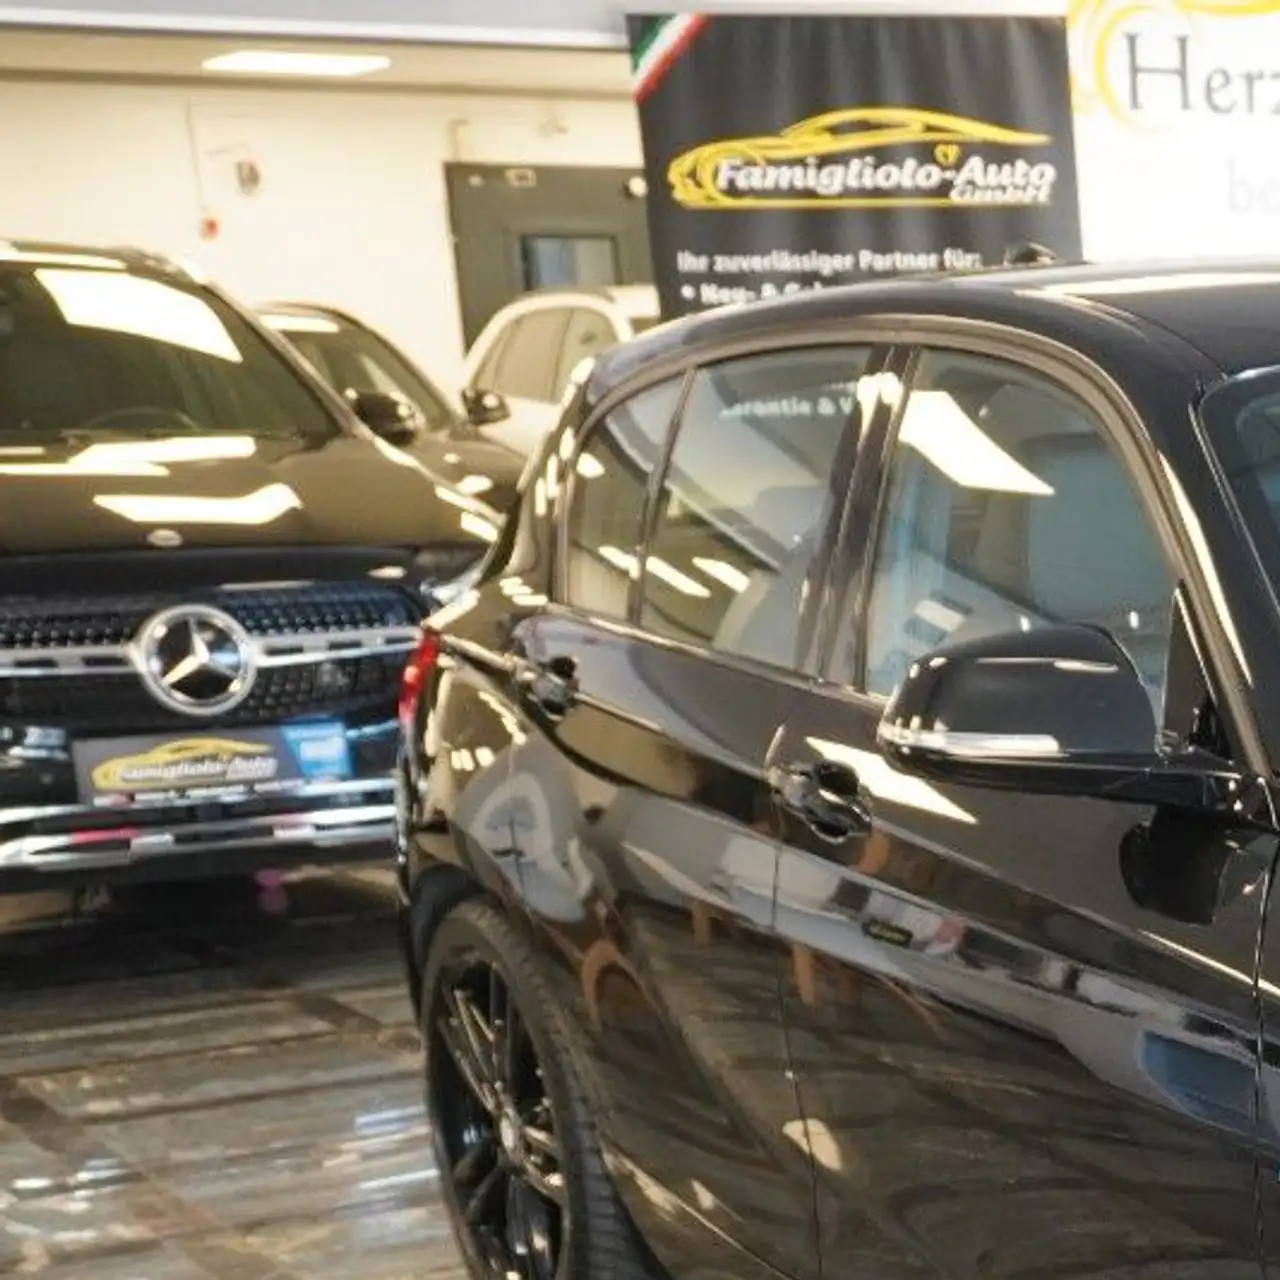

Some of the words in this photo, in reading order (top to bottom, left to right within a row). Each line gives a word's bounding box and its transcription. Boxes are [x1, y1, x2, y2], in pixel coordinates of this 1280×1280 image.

[677, 251, 708, 274] Ihr
[712, 249, 854, 277] zuverlässiger
[858, 249, 938, 274] Partner
